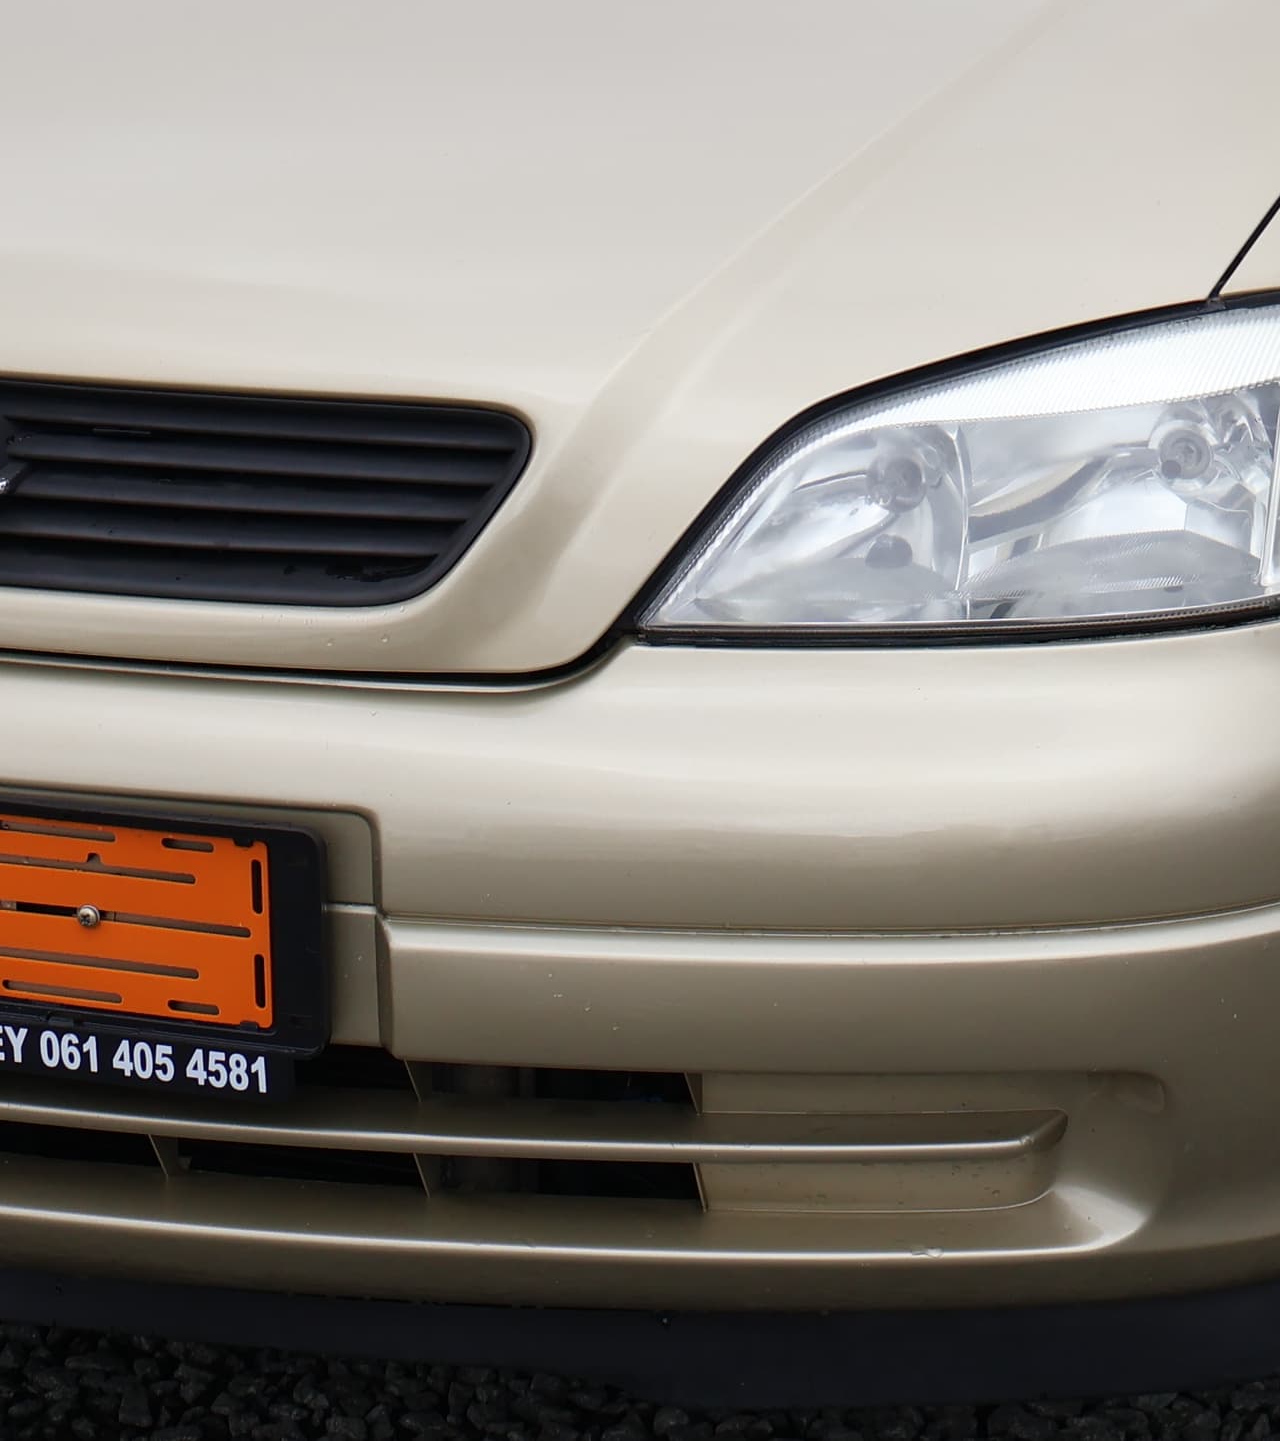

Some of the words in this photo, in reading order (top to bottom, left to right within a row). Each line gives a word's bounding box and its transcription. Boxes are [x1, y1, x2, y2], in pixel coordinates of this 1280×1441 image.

[40, 1030, 99, 1073] 061
[112, 1039, 175, 1082] 405
[186, 1048, 268, 1094] 4581
